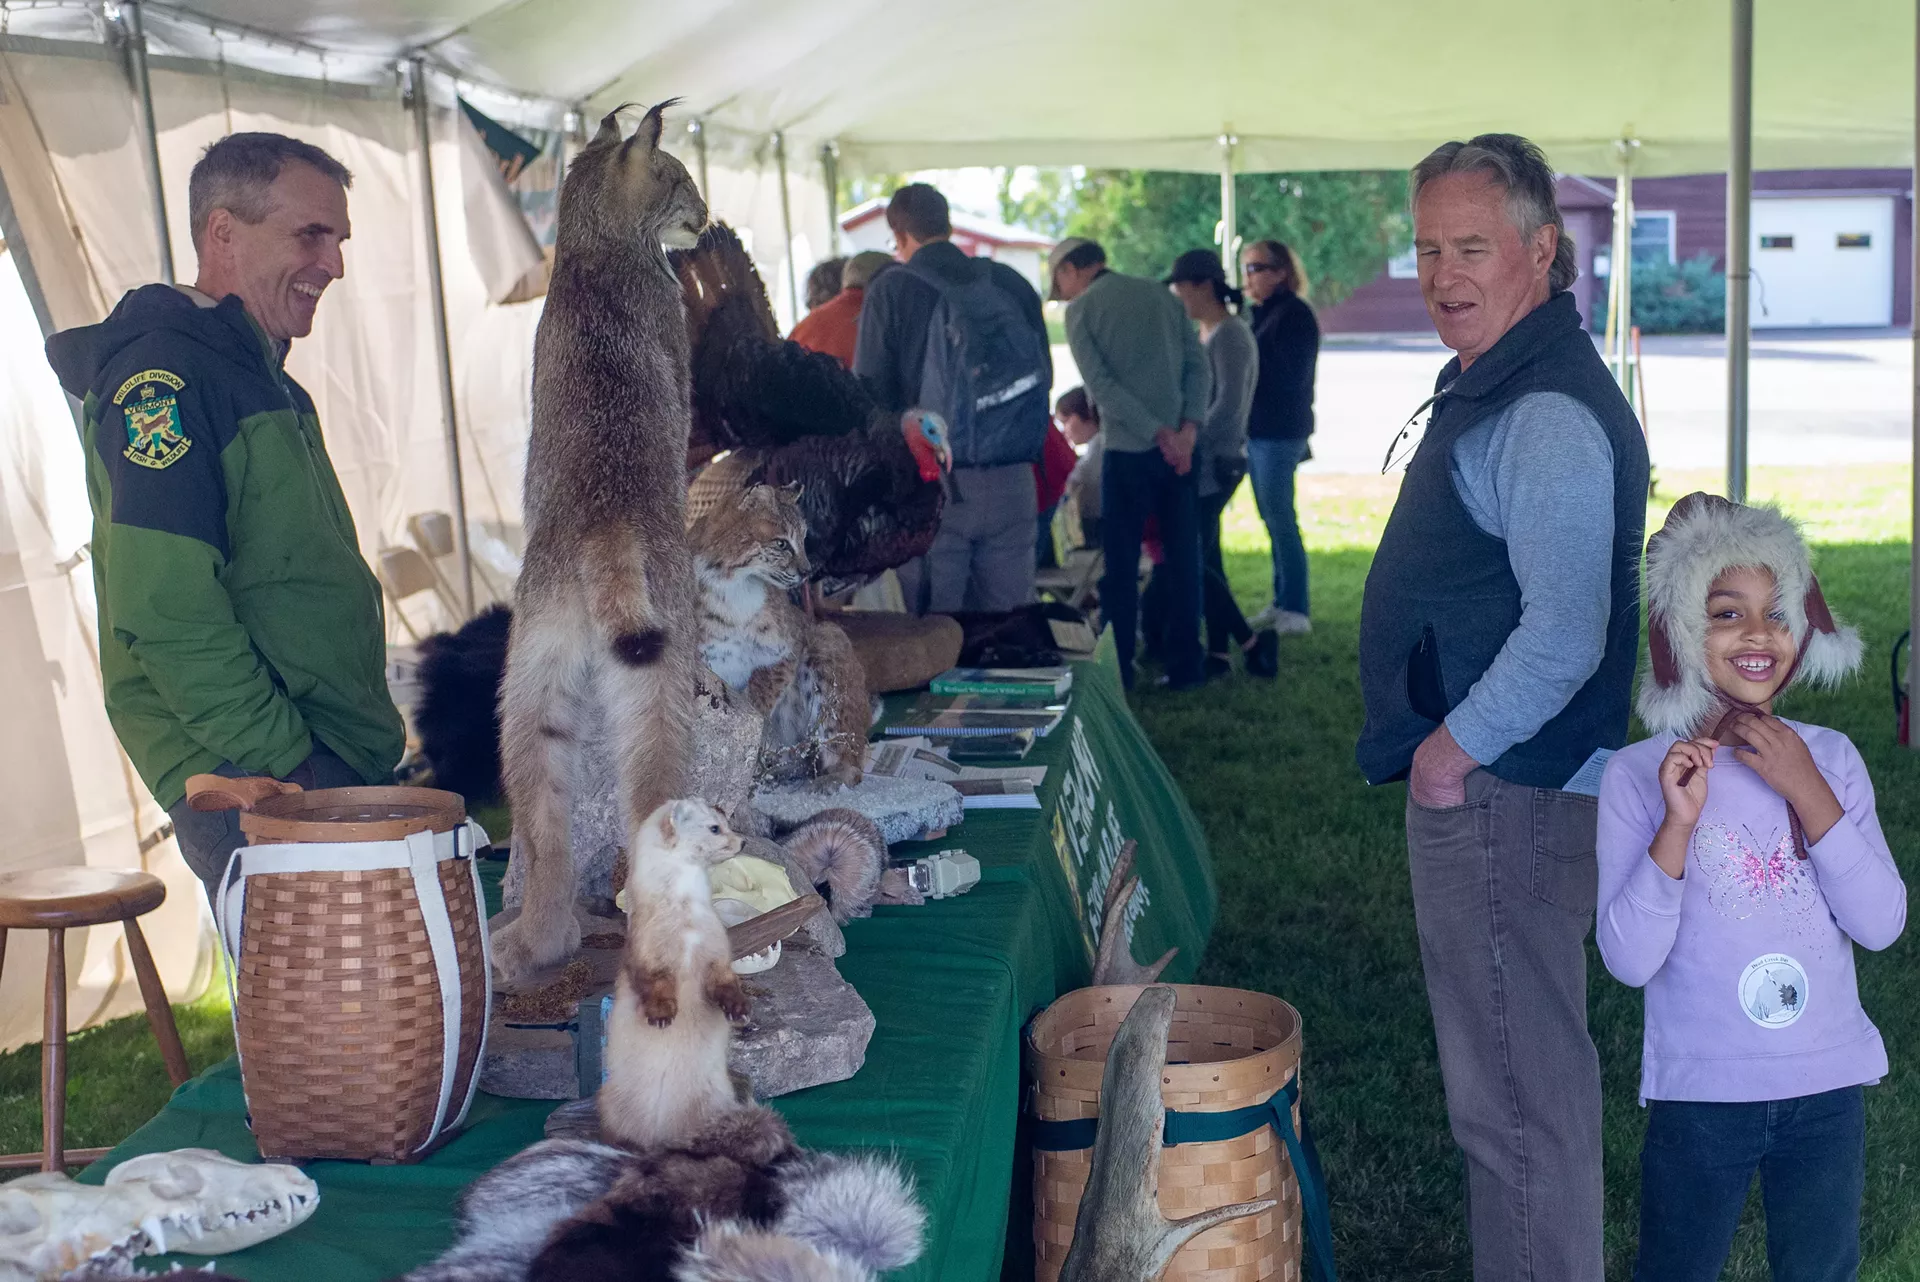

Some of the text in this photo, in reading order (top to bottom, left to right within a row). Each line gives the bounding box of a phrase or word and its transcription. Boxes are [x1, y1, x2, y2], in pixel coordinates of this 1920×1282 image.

[115, 372, 183, 402] WILDLIFE DIVISION
[128, 399, 173, 414] VERMONT
[133, 453, 148, 463] FISH
[161, 444, 186, 466] WILDLIFE
